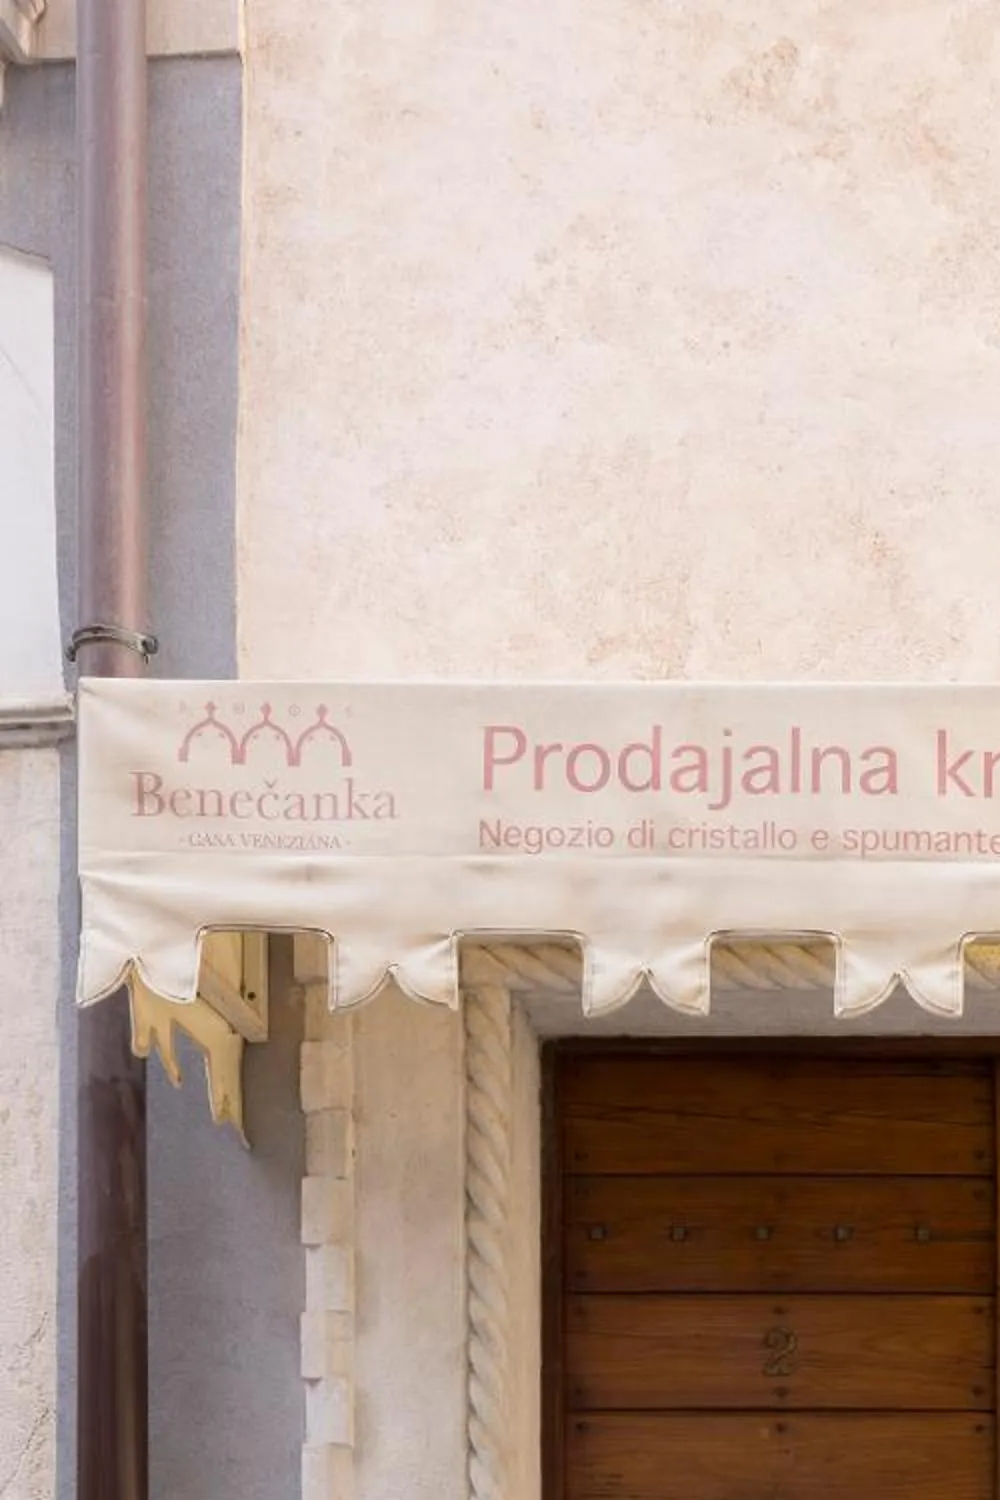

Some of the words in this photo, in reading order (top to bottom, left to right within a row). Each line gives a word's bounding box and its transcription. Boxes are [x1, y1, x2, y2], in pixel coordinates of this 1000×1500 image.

[482, 725, 900, 811] Prodajalna
[129, 770, 399, 821] Benečanka
[239, 832, 343, 851] VENEZIANA
[477, 818, 615, 855] Negozio
[626, 818, 656, 850] di
[667, 820, 799, 852] cristallo
[809, 829, 831, 851] e
[762, 1326, 798, 1378] 2
